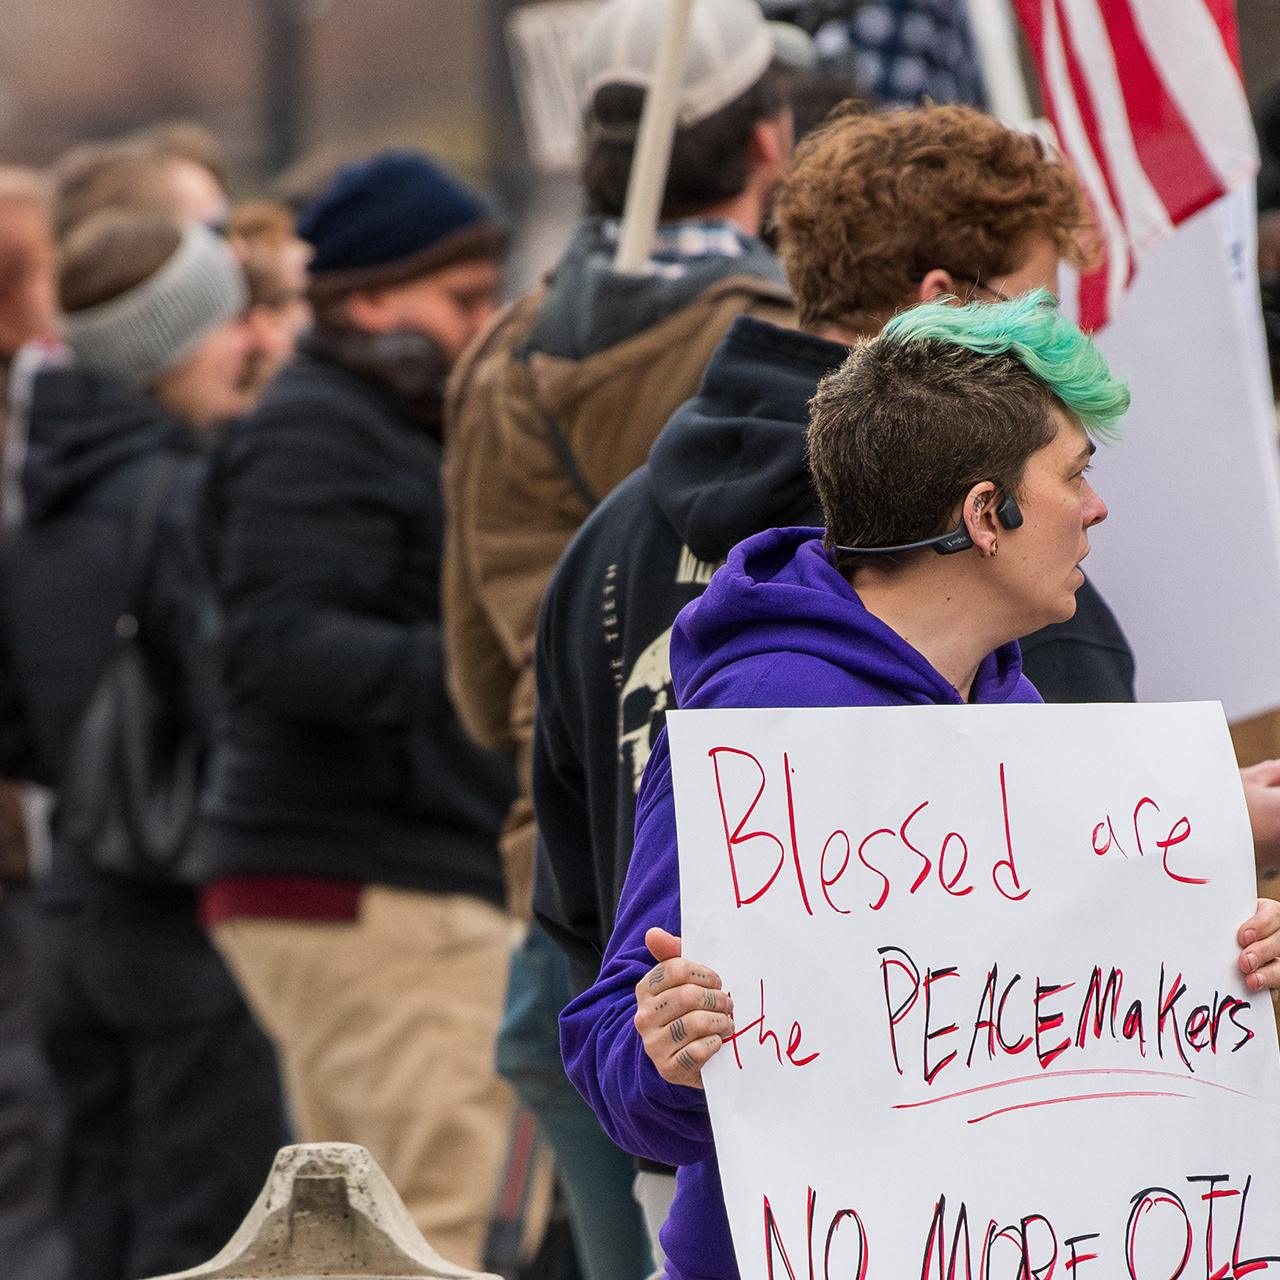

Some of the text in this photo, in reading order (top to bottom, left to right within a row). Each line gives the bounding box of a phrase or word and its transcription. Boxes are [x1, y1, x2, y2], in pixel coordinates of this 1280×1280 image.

[707, 745, 1211, 917] Blessed are
[720, 977, 821, 1071] the
